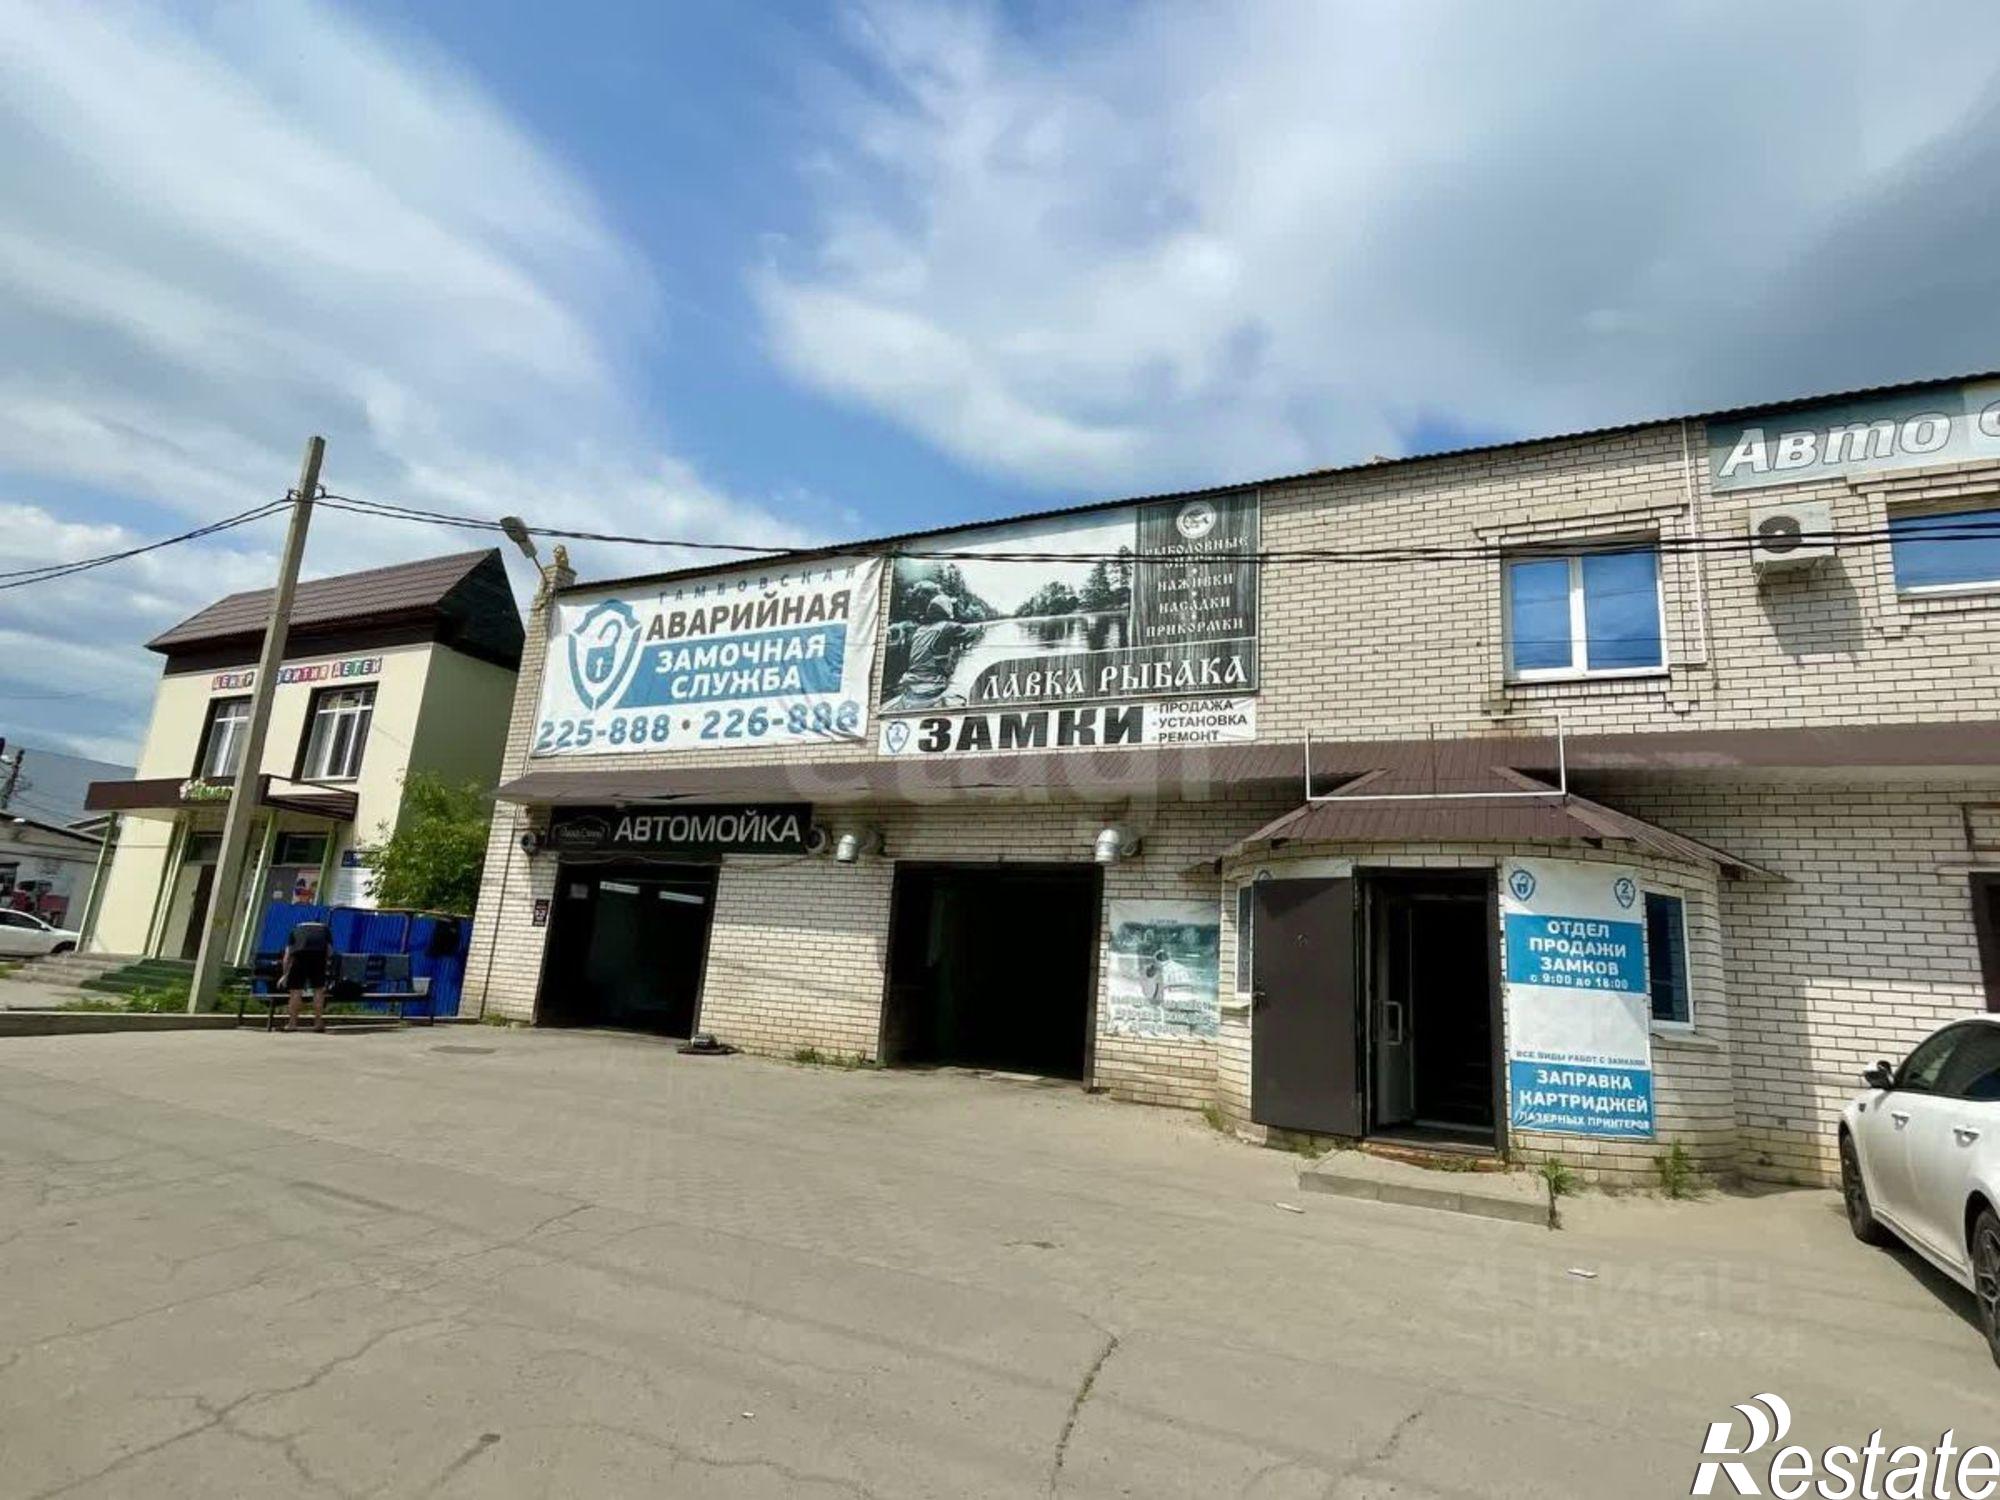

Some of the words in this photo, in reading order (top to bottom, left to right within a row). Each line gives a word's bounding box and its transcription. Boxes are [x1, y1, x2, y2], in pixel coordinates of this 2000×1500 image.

[646, 589, 850, 642] АВАРИЙНАЯ
[1146, 617, 1243, 637] ПРИКОРМКИ
[655, 634, 826, 674] ЗАМОЧНАЯ
[670, 665, 802, 699] СЛУЖБА
[983, 668, 1085, 700] ЛАВКА
[1098, 655, 1249, 692] РЫБАКА
[536, 713, 671, 751] 225-888
[700, 700, 860, 740] 226-888
[917, 706, 1144, 752] ЗАМКИ
[1158, 714, 1248, 729] УСТАНОВКА
[1158, 730, 1219, 743] РЕМОНТ
[614, 809, 801, 843] АВТОМОЙКА
[1547, 921, 1610, 938] ОТДЕЛ
[1529, 937, 1626, 958] ПРОДАЖИ
[1540, 956, 1619, 976] ЗАМКОВ
[1537, 1069, 1632, 1091] ЗАПРАВКА
[1518, 1089, 1648, 1114] КАРТРИДЖЕЙ
